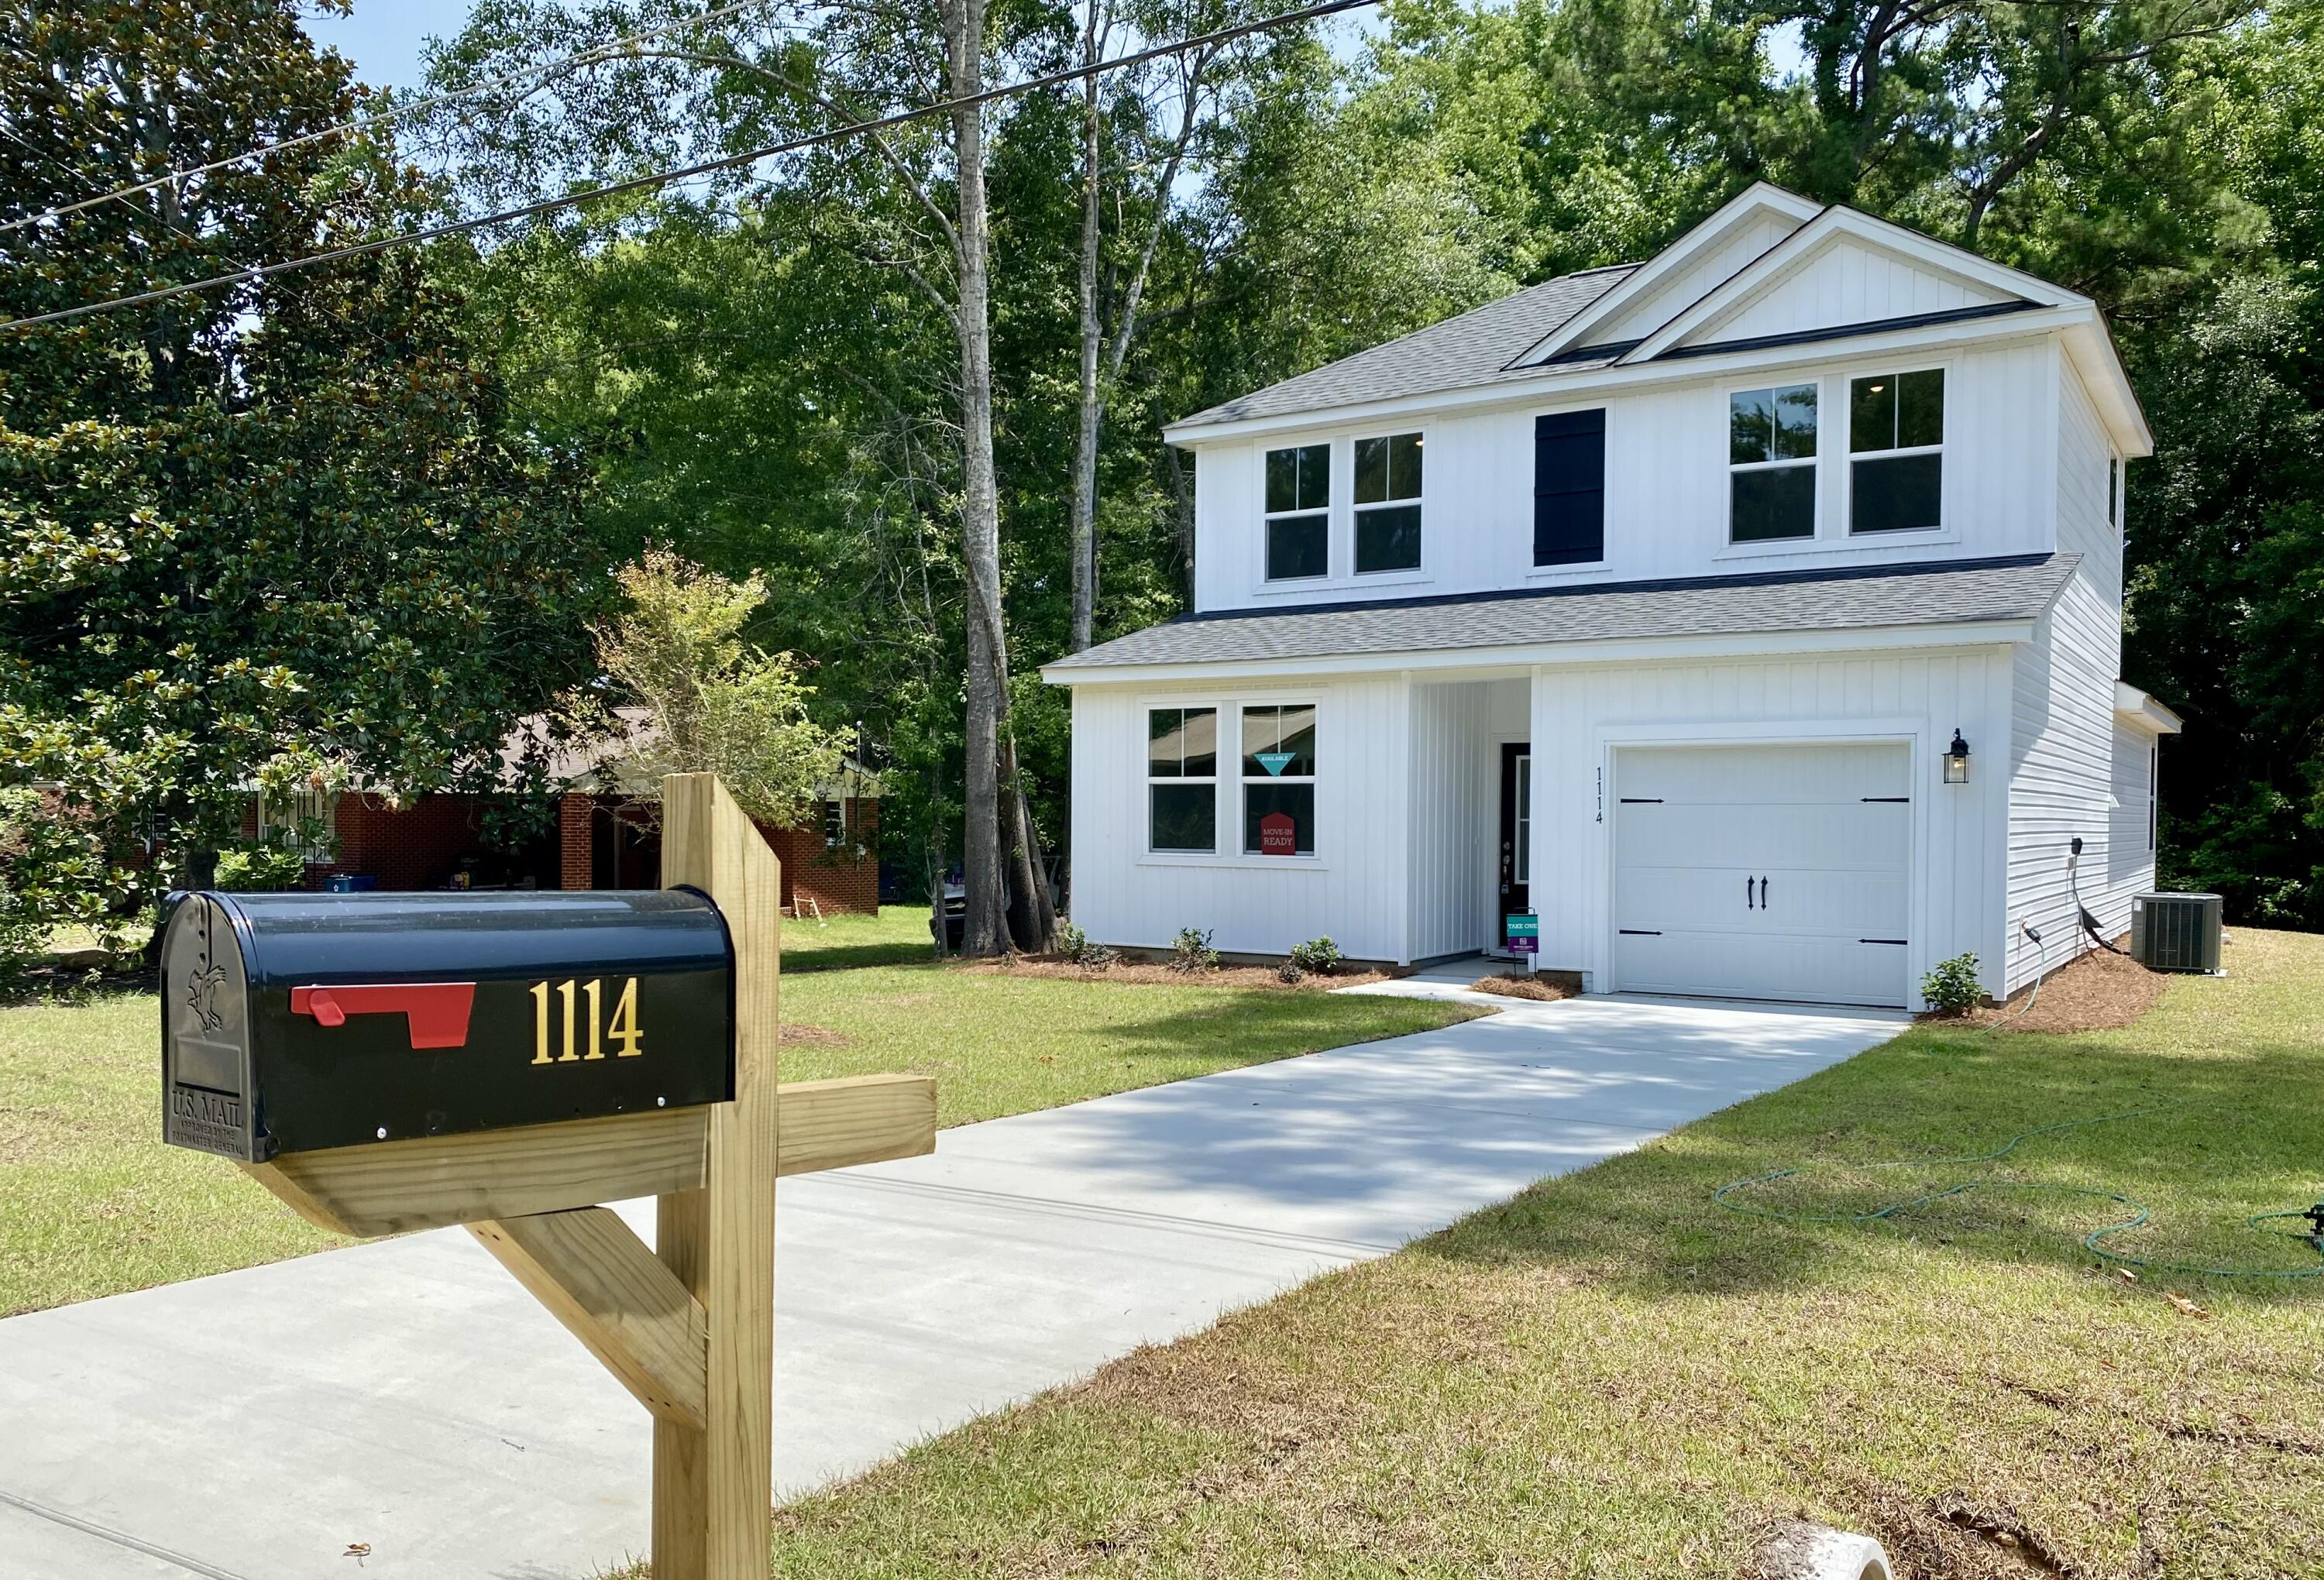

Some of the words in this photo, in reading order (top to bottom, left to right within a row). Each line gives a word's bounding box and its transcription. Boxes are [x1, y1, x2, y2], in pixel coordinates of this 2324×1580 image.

[1263, 836, 1293, 846] READY
[529, 977, 645, 1065] 1114
[172, 1091, 197, 1120] U.S.
[201, 1095, 244, 1130] MAIL
[180, 1120, 211, 1137] APPROVED
[213, 1127, 221, 1138] BY
[222, 1128, 235, 1141] THE
[172, 1131, 211, 1148] POSTMASTER
[214, 1140, 243, 1156] GENERAL
